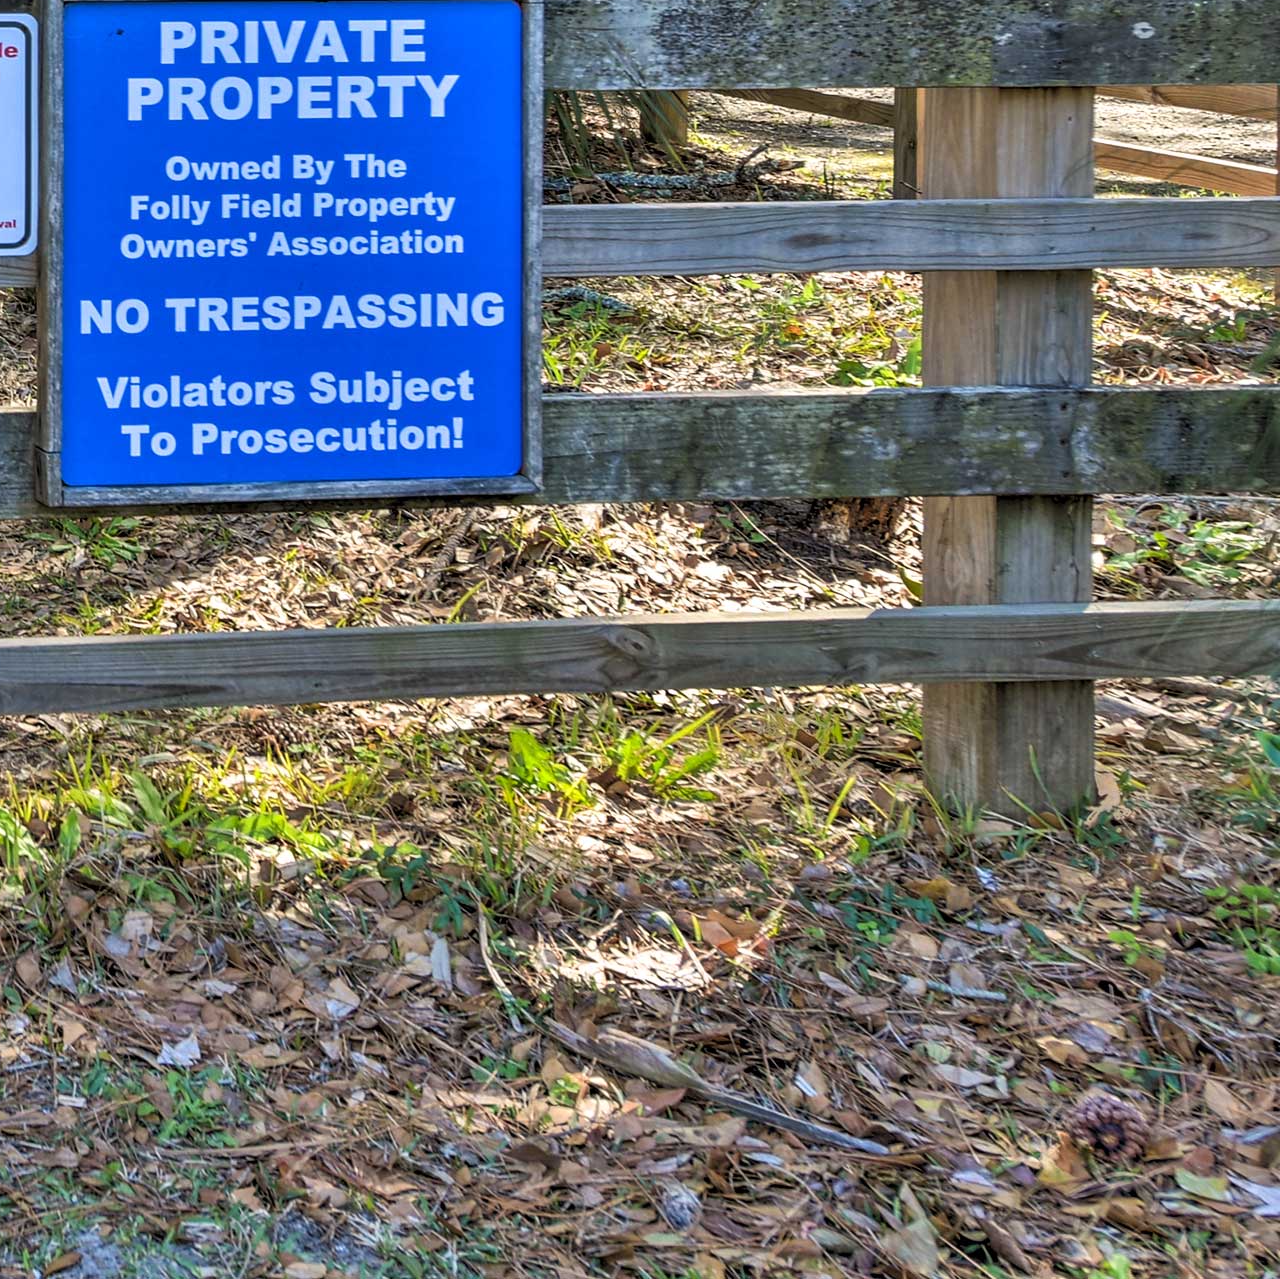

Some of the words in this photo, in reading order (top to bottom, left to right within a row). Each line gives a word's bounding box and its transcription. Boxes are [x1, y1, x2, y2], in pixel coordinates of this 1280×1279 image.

[160, 19, 426, 65] PRIVATE
[127, 73, 460, 121] PROPERTY
[165, 154, 281, 182] Owned
[293, 154, 335, 186] By
[344, 153, 407, 179] The
[130, 194, 211, 226] Folly
[221, 192, 301, 220] Field
[313, 191, 456, 223] Property
[120, 231, 257, 259] Owners'
[267, 229, 464, 257] Association
[80, 297, 150, 335] NO
[165, 291, 505, 332] TRESPASSING
[96, 374, 295, 409] Violators
[309, 369, 475, 411] Subject
[120, 423, 177, 457] To
[192, 416, 464, 455] Prosecution!
